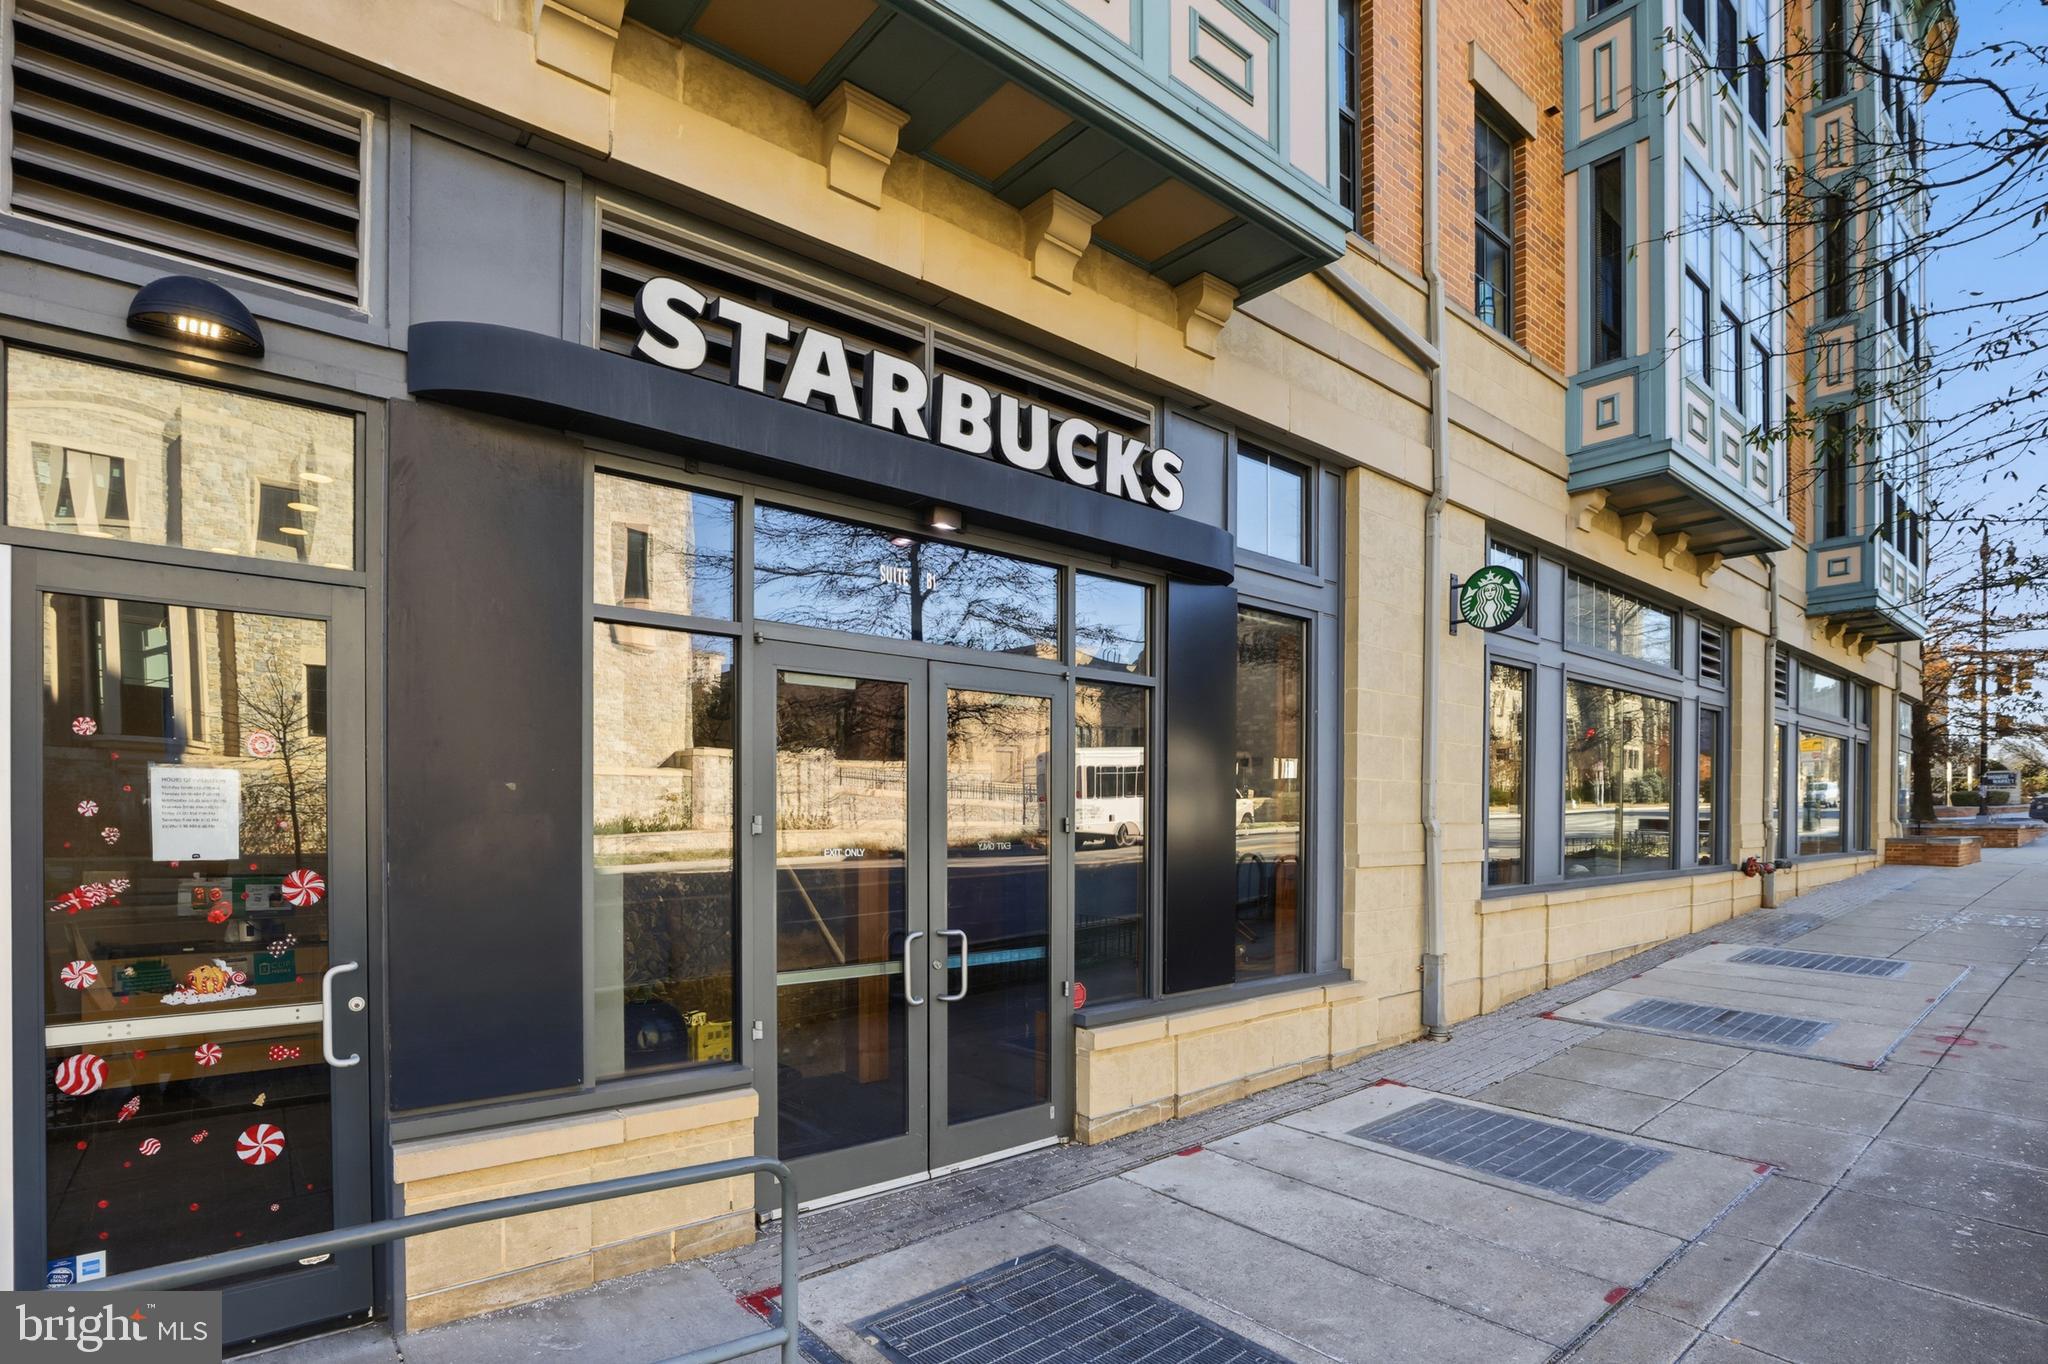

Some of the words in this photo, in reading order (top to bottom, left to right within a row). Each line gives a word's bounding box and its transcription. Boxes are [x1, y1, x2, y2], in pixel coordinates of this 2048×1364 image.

[634, 276, 1185, 512] STARBUCKS
[880, 564, 909, 586] SUITE
[823, 848, 842, 857] EXIT
[844, 848, 866, 857] ONLY
